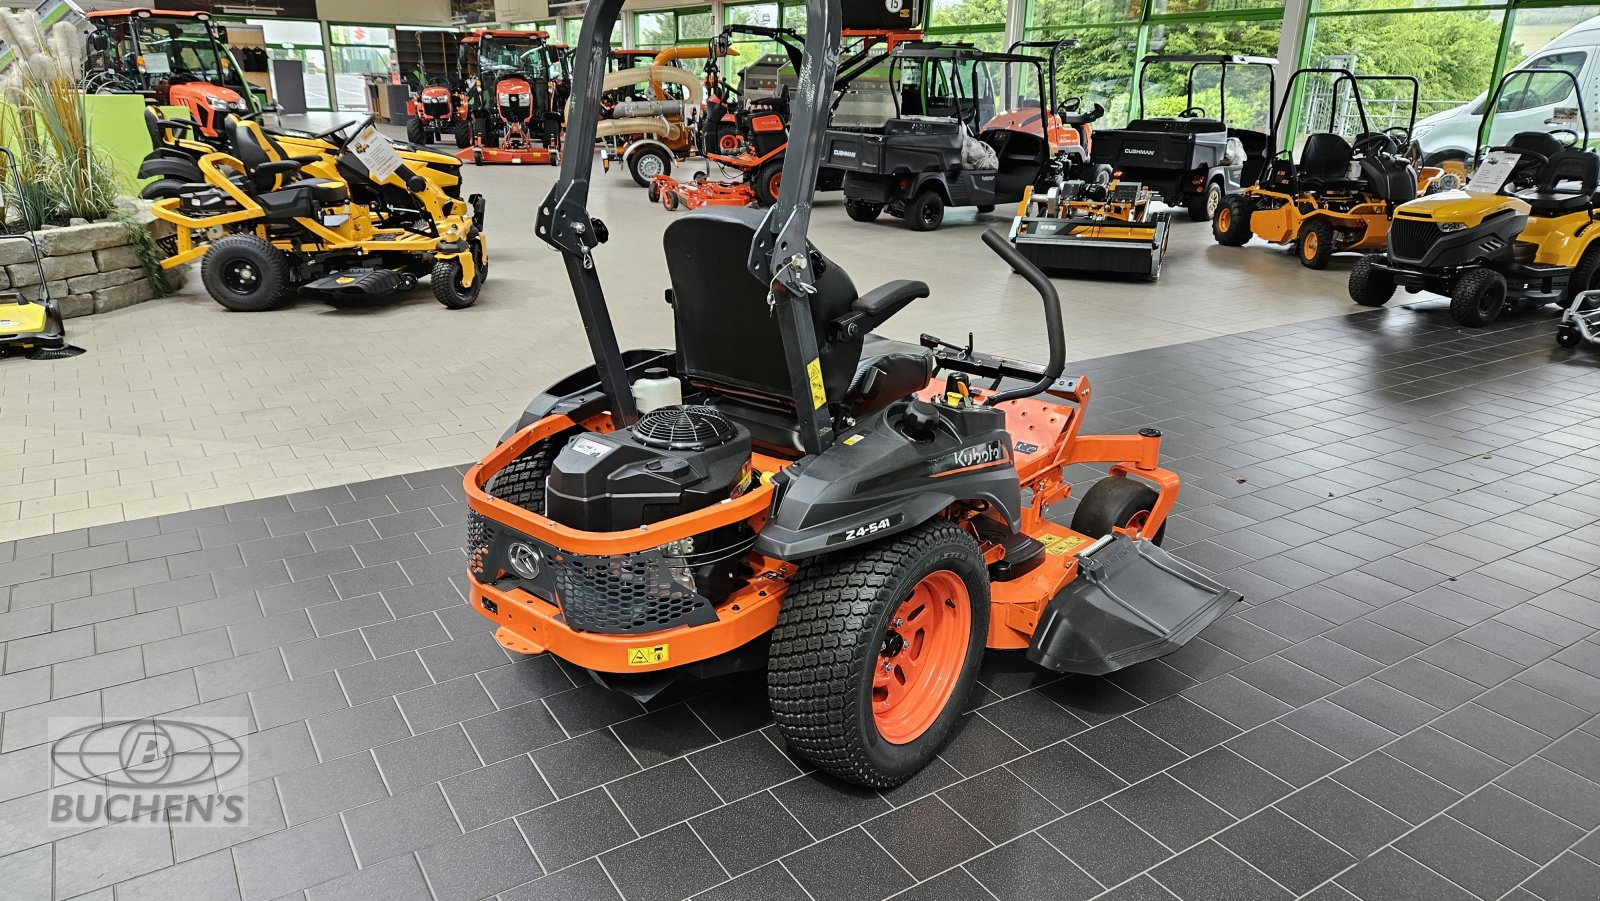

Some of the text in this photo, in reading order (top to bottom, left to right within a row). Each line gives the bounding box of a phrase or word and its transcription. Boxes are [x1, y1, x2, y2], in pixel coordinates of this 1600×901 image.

[1124, 148, 1155, 156] CUSHMAN
[953, 444, 999, 467] Kubota
[845, 518, 891, 541] Z4-541
